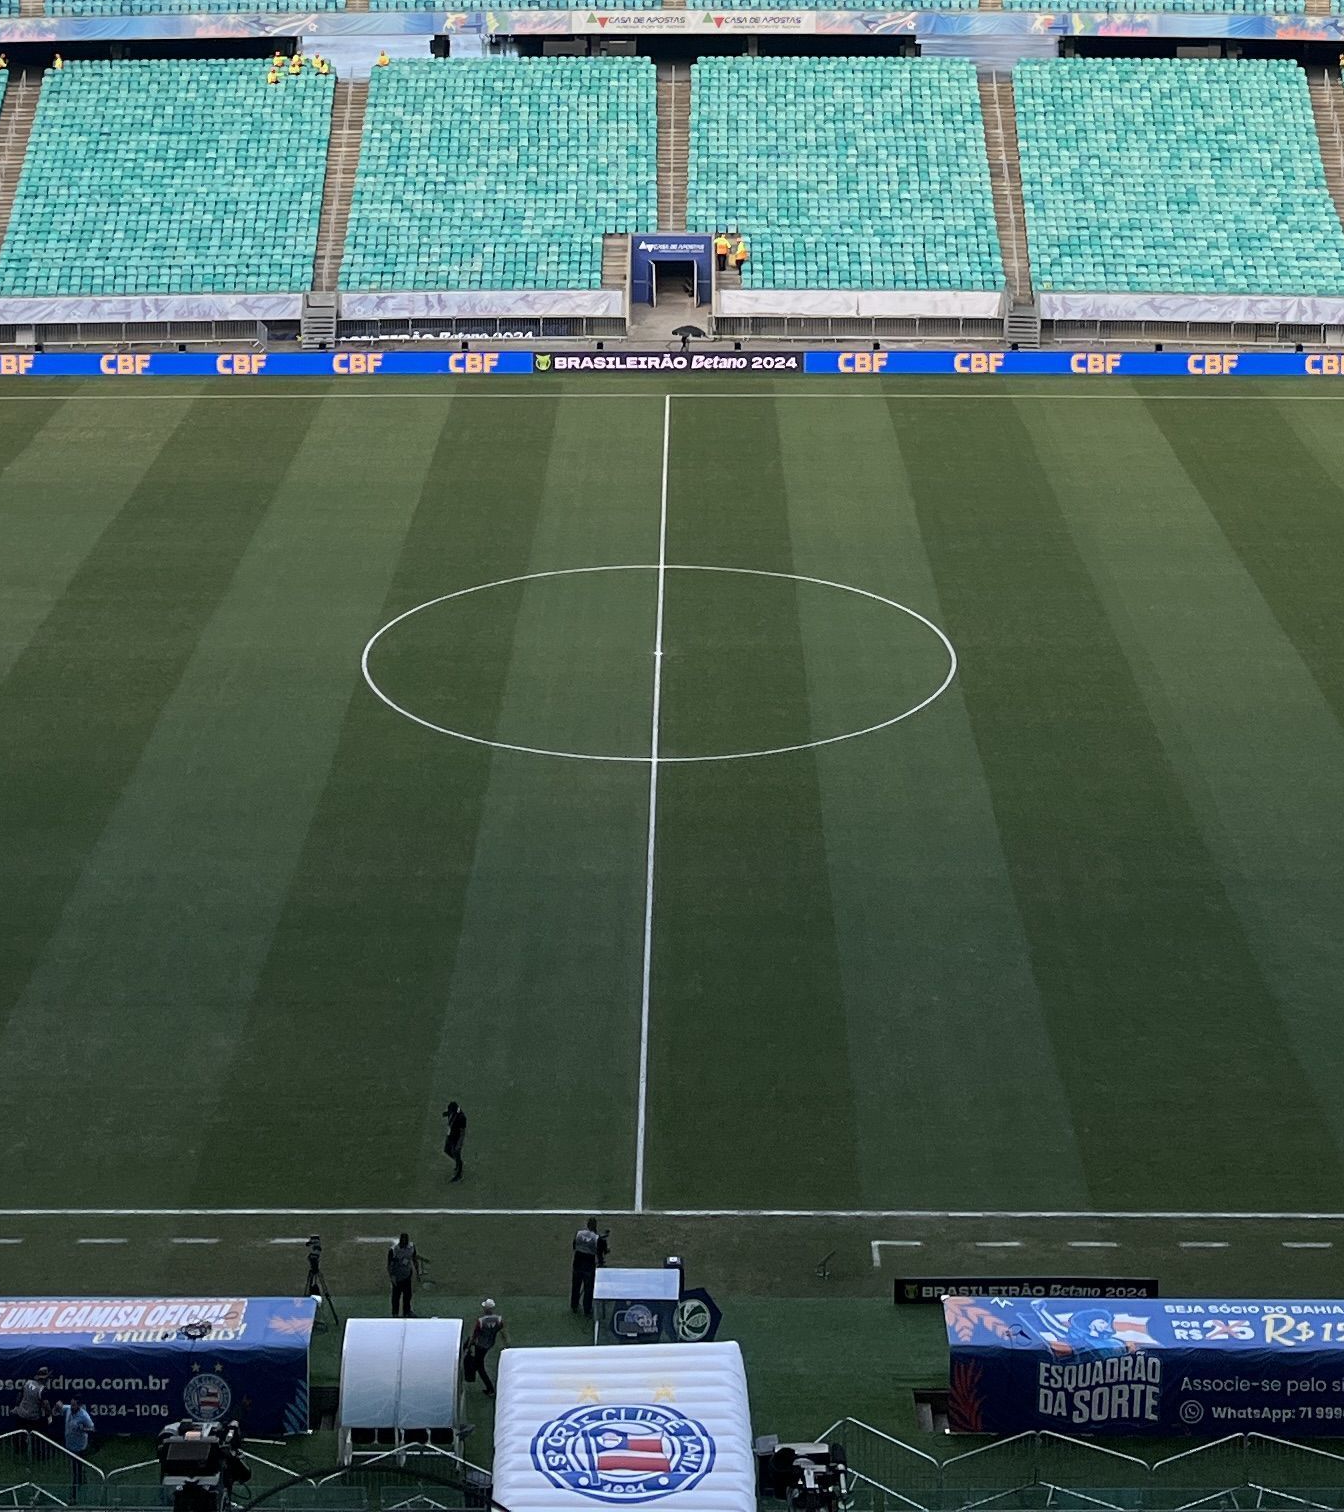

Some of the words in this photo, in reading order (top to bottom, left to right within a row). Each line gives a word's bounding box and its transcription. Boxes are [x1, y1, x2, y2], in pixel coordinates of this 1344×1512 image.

[608, 16, 632, 24] CASA
[633, 16, 646, 24] DE
[646, 16, 686, 24] APOSTAS
[724, 16, 748, 24] CASA
[748, 16, 761, 24] DE
[761, 16, 802, 24] APOSTAS
[100, 354, 151, 375] CBF
[216, 354, 267, 375] CBF
[332, 353, 383, 374] CBF
[448, 352, 499, 374] CBF
[554, 352, 688, 370] BRASILEIRÃO
[690, 353, 747, 370] Betano
[750, 355, 798, 370] 2024
[838, 352, 888, 373] CBF
[954, 352, 1004, 373] CBF
[1070, 353, 1121, 374] CBF
[1187, 354, 1238, 375] CBF
[921, 1283, 1046, 1298] BRASILEIRÃO
[1049, 1284, 1101, 1298] Betano
[1106, 1286, 1148, 1299] 2024
[4, 1305, 58, 1329] UMA
[58, 1304, 147, 1328] CAMISA
[144, 1303, 232, 1327] OFICIAL
[1164, 1304, 1205, 1315] SEJA
[1207, 1302, 1260, 1315] SÓCIO
[1262, 1304, 1288, 1315] DO
[1290, 1304, 1344, 1315] BAHIA
[1171, 1319, 1201, 1329] POR
[1174, 1328, 1203, 1340] R$
[1203, 1319, 1255, 1341] 25
[1261, 1313, 1315, 1346] R$
[1039, 1350, 1161, 1387] ESQUADRÃO
[1181, 1375, 1282, 1392] Associe-se
[1286, 1375, 1327, 1396] pelo
[89, 1403, 170, 1418] 3034-1006
[1039, 1391, 1068, 1418] DA
[1072, 1385, 1160, 1423] SORTE
[1211, 1405, 1296, 1422] WhatsApp:
[1299, 1406, 1312, 1420] 71
